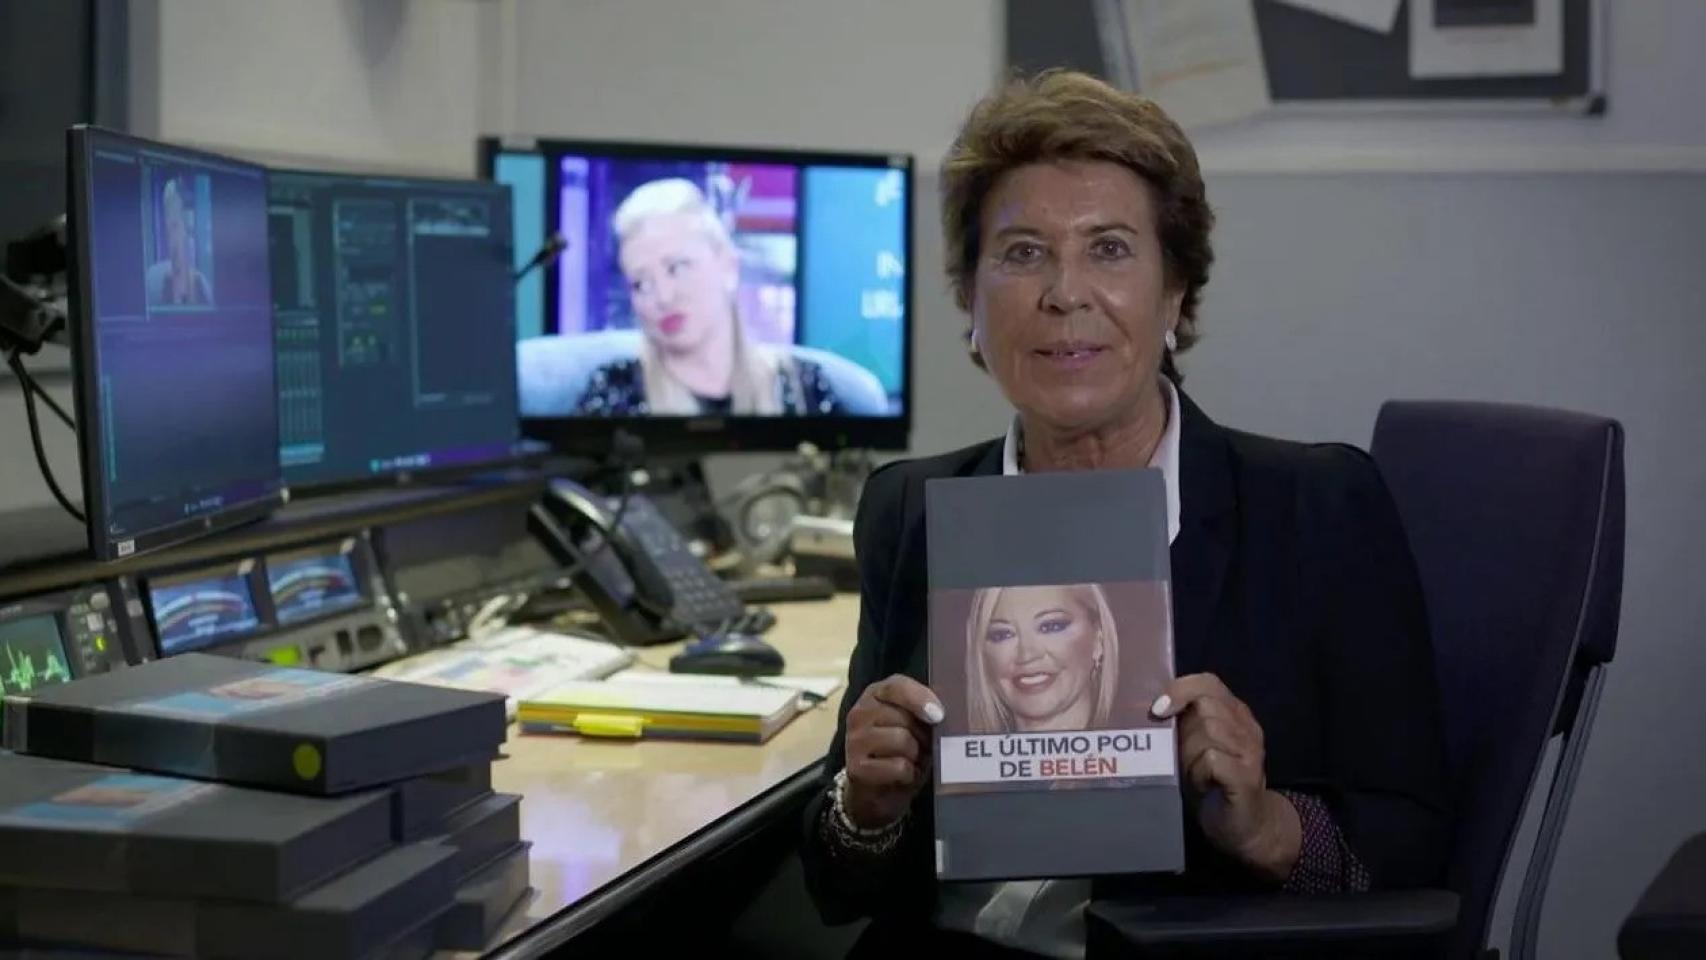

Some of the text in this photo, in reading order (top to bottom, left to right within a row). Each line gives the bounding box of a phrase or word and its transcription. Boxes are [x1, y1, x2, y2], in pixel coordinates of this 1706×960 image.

[965, 733, 1151, 757] EL ÚLTIMO POLI
[1000, 753, 1117, 777] DE BELÉN
